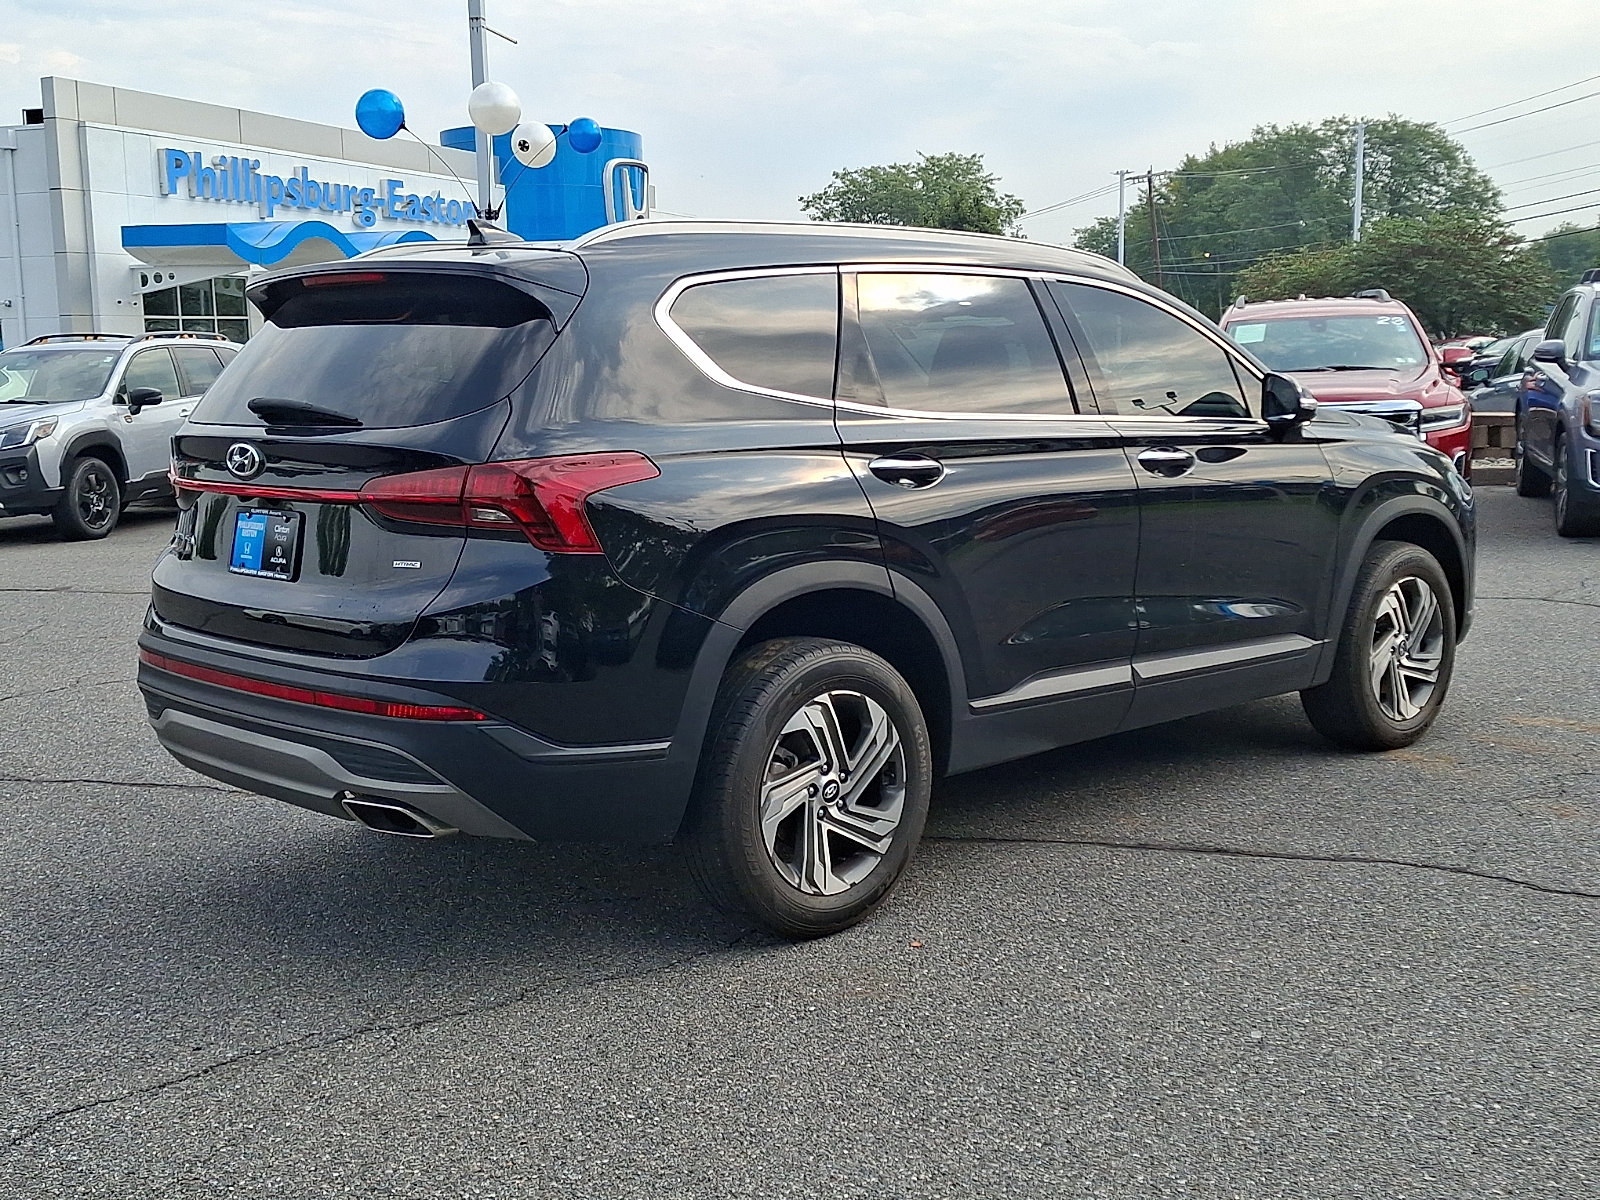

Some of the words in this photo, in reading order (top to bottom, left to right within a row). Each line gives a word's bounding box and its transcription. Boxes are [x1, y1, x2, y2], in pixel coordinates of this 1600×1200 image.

[158, 148, 477, 227] Phillipsburg-Easton
[274, 524, 290, 533] Clinton
[274, 533, 287, 541] Acura
[270, 556, 287, 564] ACURA
